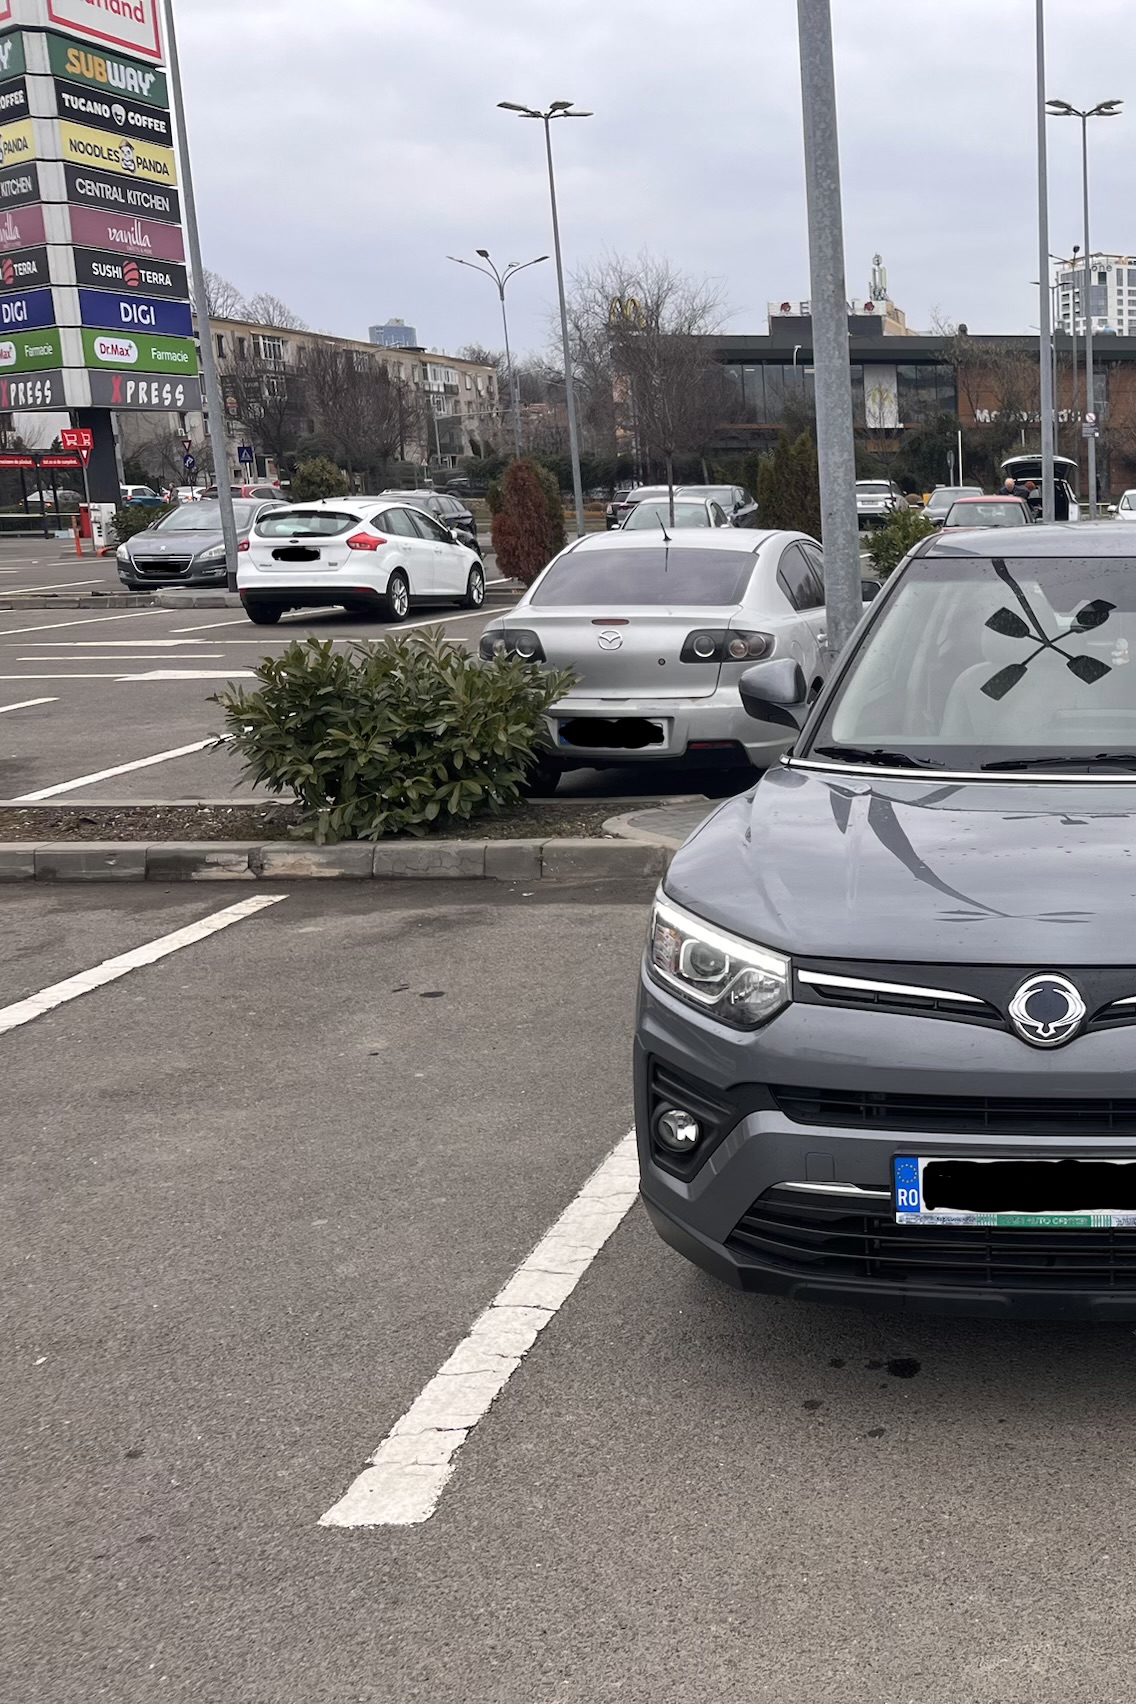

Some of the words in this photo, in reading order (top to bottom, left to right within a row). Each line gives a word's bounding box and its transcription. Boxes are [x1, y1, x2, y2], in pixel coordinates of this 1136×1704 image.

[65, 47, 156, 97] SUBWAY
[0, 90, 25, 110] OFFEE
[62, 92, 111, 119] TUCANO
[127, 112, 167, 134] COFFEE
[3, 136, 29, 155] PANDA
[69, 138, 120, 163] NOODLES
[136, 156, 170, 176] PANDA
[0, 176, 32, 196] KITCHEN
[75, 178, 126, 204] CENTRAL
[127, 189, 170, 212] KITCHEN
[107, 219, 152, 248] vanilla
[13, 260, 38, 277] TERRA
[92, 262, 123, 279] SUSHI
[140, 270, 172, 286] TERRA
[2, 300, 28, 324] DIGI
[119, 302, 156, 326] DIGI
[151, 348, 189, 363] Farmacie
[111, 375, 185, 407] XPRESS
[897, 1188, 918, 1207] RO
